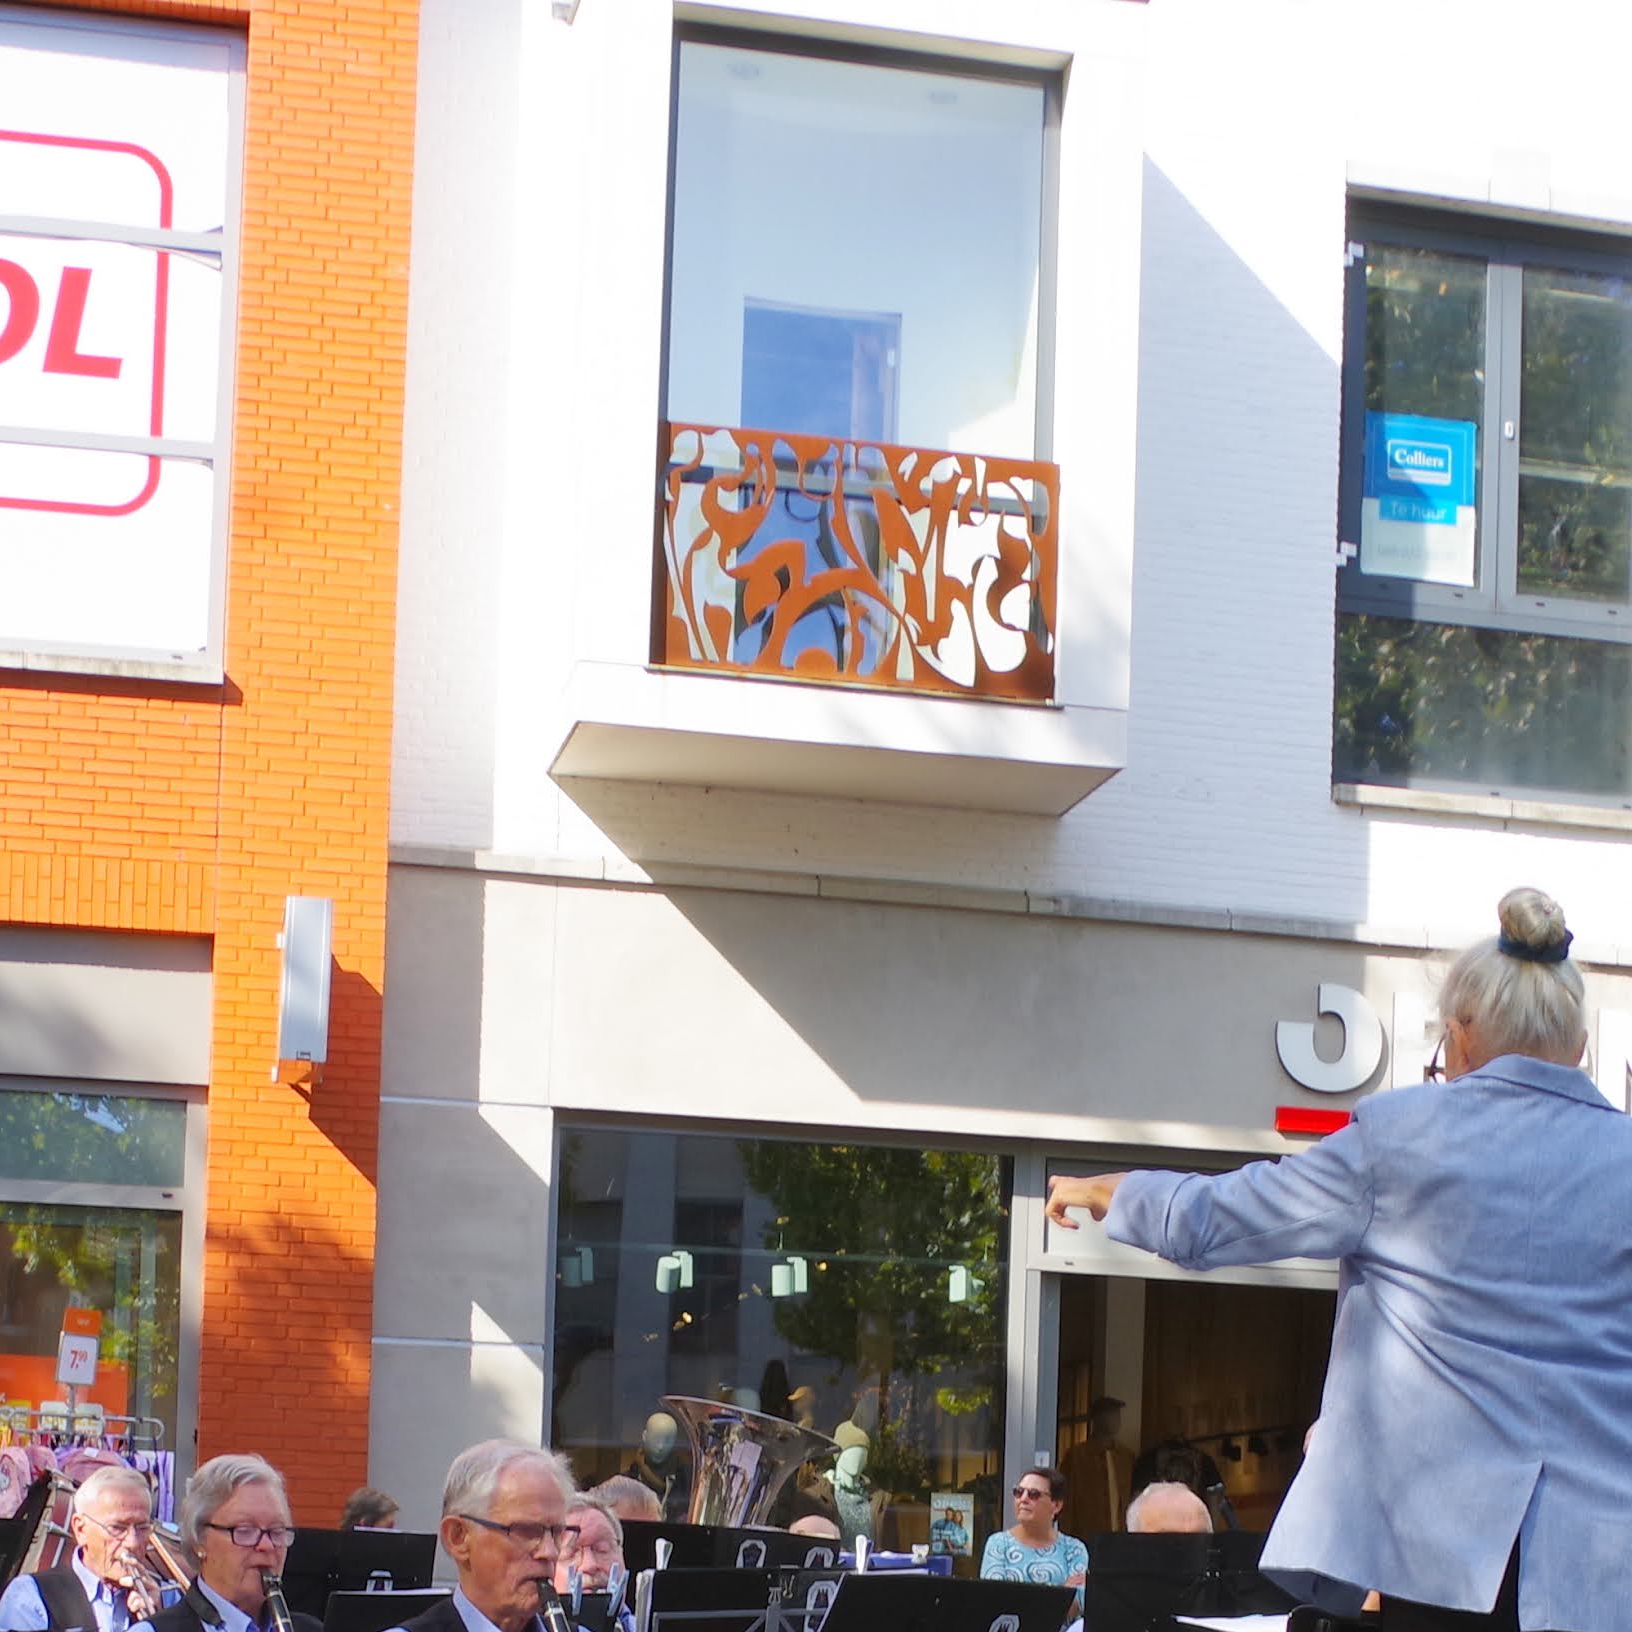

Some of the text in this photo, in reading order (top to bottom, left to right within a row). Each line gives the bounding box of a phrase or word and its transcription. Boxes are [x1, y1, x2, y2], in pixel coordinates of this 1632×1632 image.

[1393, 447, 1445, 469] Colliers
[1390, 500, 1448, 521] Te huur
